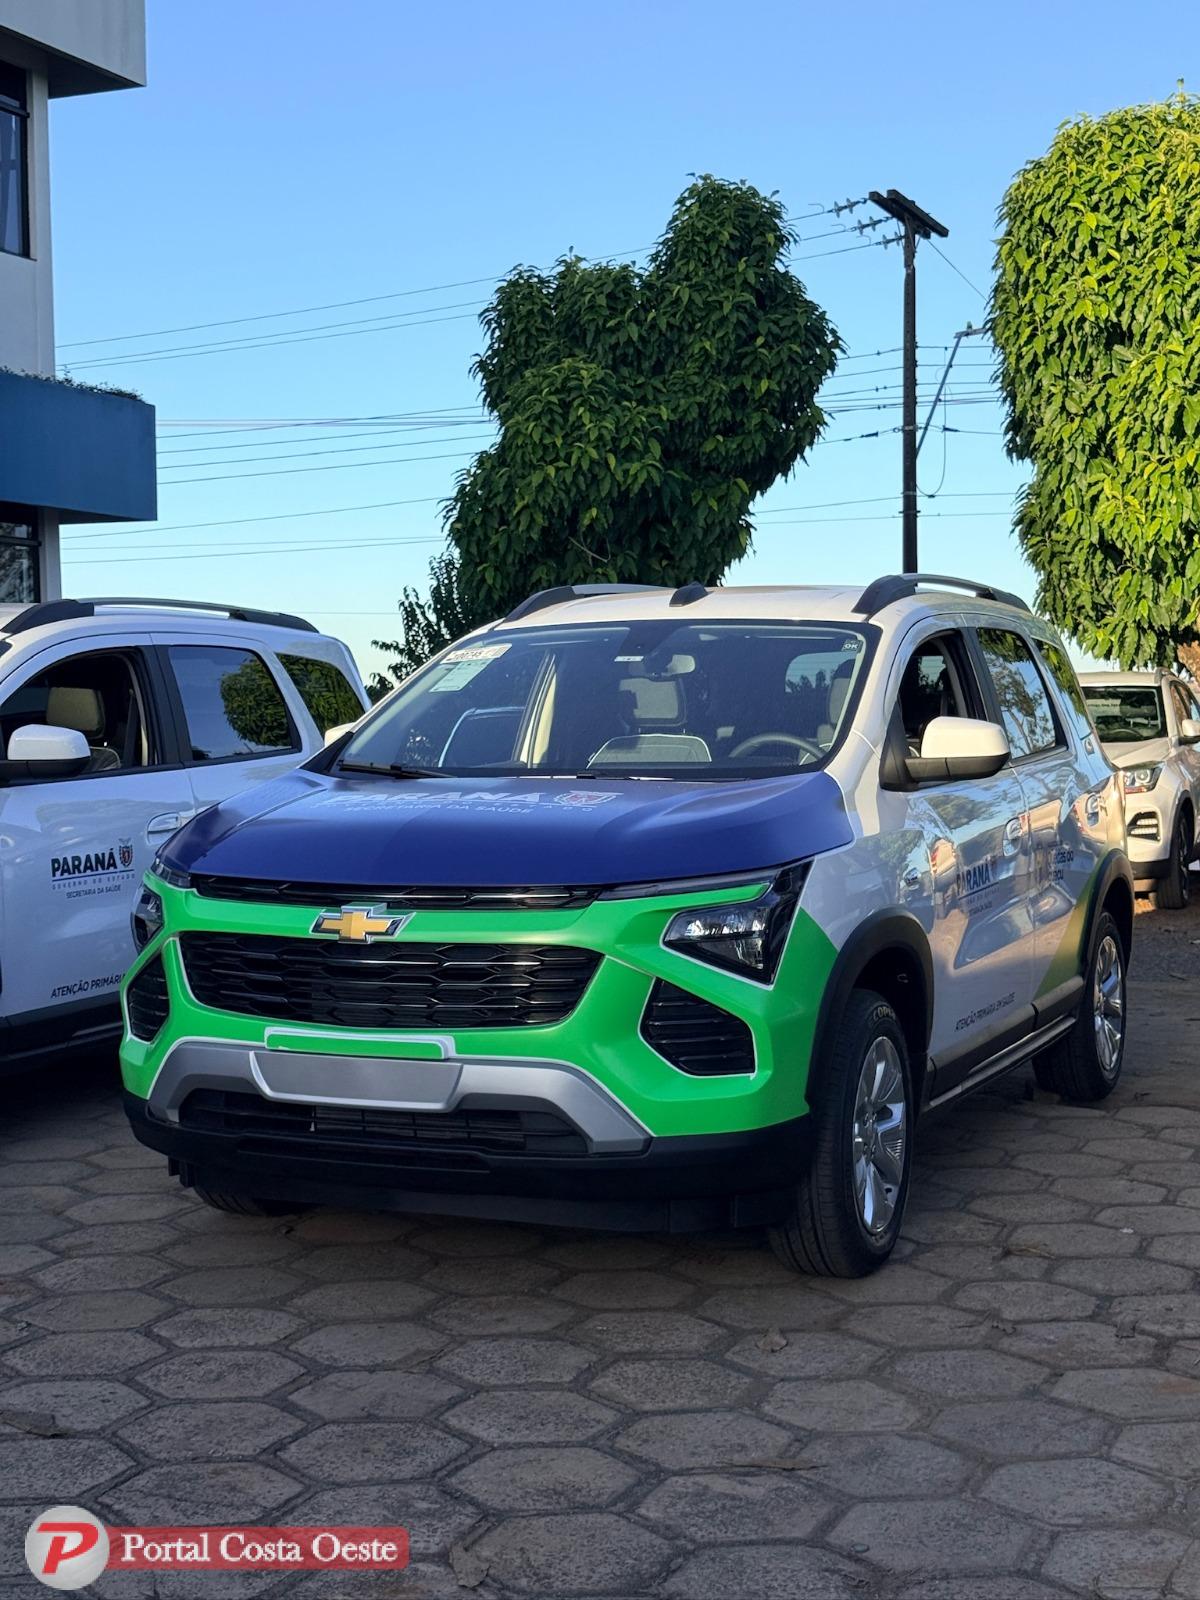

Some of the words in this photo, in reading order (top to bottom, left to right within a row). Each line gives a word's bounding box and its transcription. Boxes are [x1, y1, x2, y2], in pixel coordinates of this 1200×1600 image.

[51, 848, 117, 878] PARANÁ
[66, 887, 96, 899] SECRETARIA
[51, 980, 89, 999] ATENÇÃO
